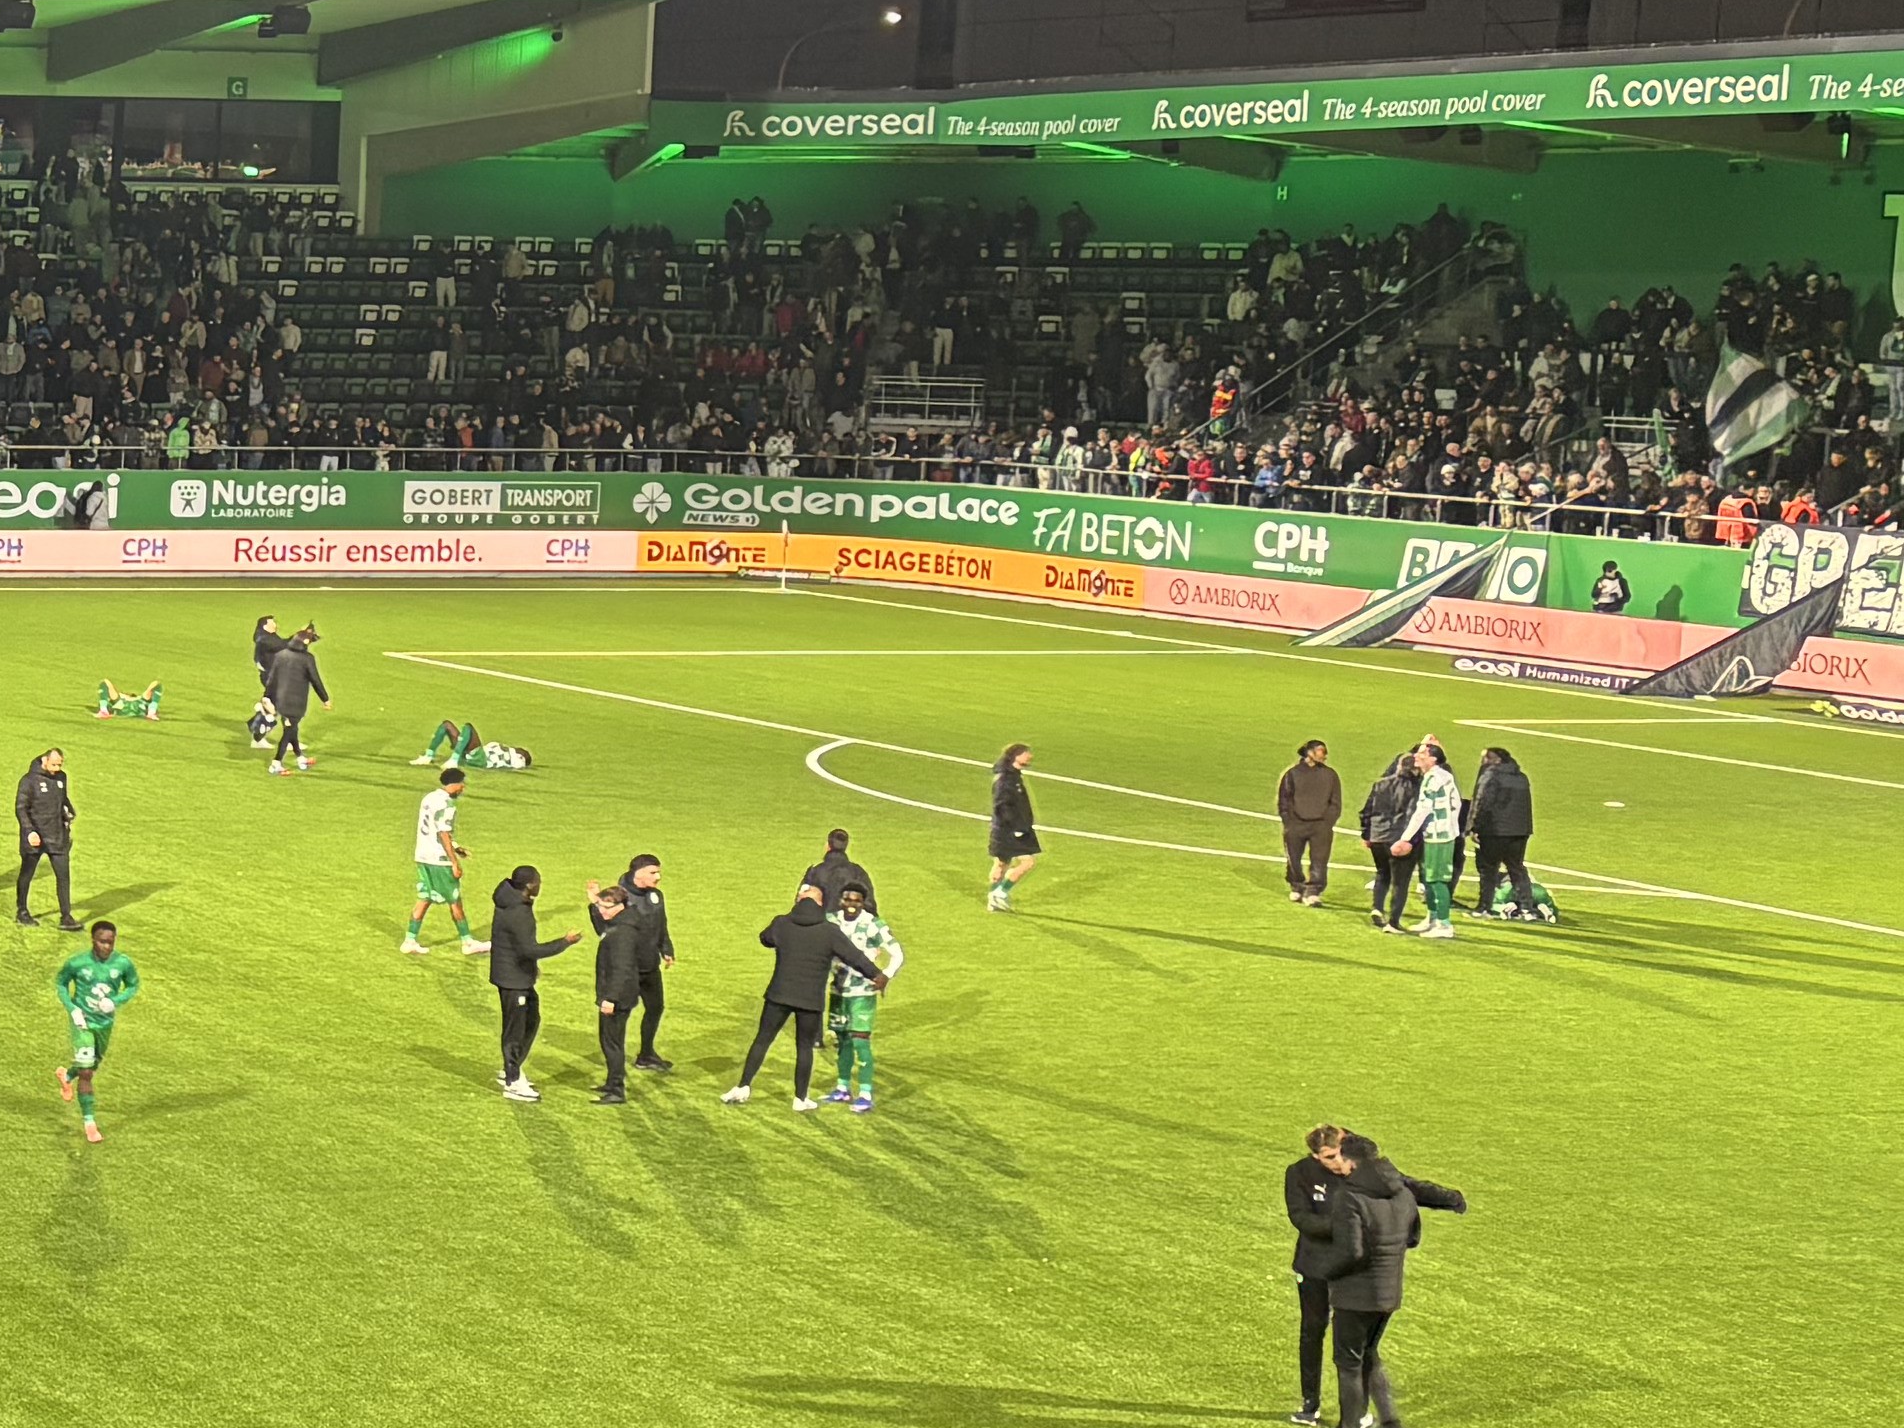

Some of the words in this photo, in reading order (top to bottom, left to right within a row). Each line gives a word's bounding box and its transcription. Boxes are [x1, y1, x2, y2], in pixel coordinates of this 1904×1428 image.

[231, 79, 244, 96] G
[1624, 64, 1789, 107] coverseal
[1809, 74, 1852, 100] The
[1179, 89, 1309, 127] coverseal
[1323, 97, 1356, 120] The
[1361, 94, 1440, 117] 4-season
[1445, 90, 1487, 118] pool
[1492, 91, 1545, 112] cover
[761, 106, 935, 138] coverseal
[946, 115, 972, 136] The
[975, 116, 1039, 138] 4-season
[1042, 114, 1075, 141] pool
[1078, 116, 1121, 135] cover
[211, 476, 347, 513] Nutergia
[411, 488, 494, 507] GOBERT
[506, 488, 594, 509] TRANSPORT
[211, 507, 294, 519] LABORATOIRE
[403, 513, 495, 525] GROUPE
[512, 514, 600, 526] GOBERT
[687, 512, 744, 526] NEWS
[122, 538, 169, 558] CPH
[233, 536, 339, 563] Réussir
[346, 538, 484, 563] ensemble.
[546, 538, 591, 557] CPH
[1253, 520, 1330, 564] CPH
[1286, 562, 1324, 577] Banque
[1191, 584, 1282, 616] AMBIORIX
[1439, 611, 1545, 647] AMBIORIX
[1525, 665, 1611, 688] Humanized
[1614, 677, 1629, 690] IT
